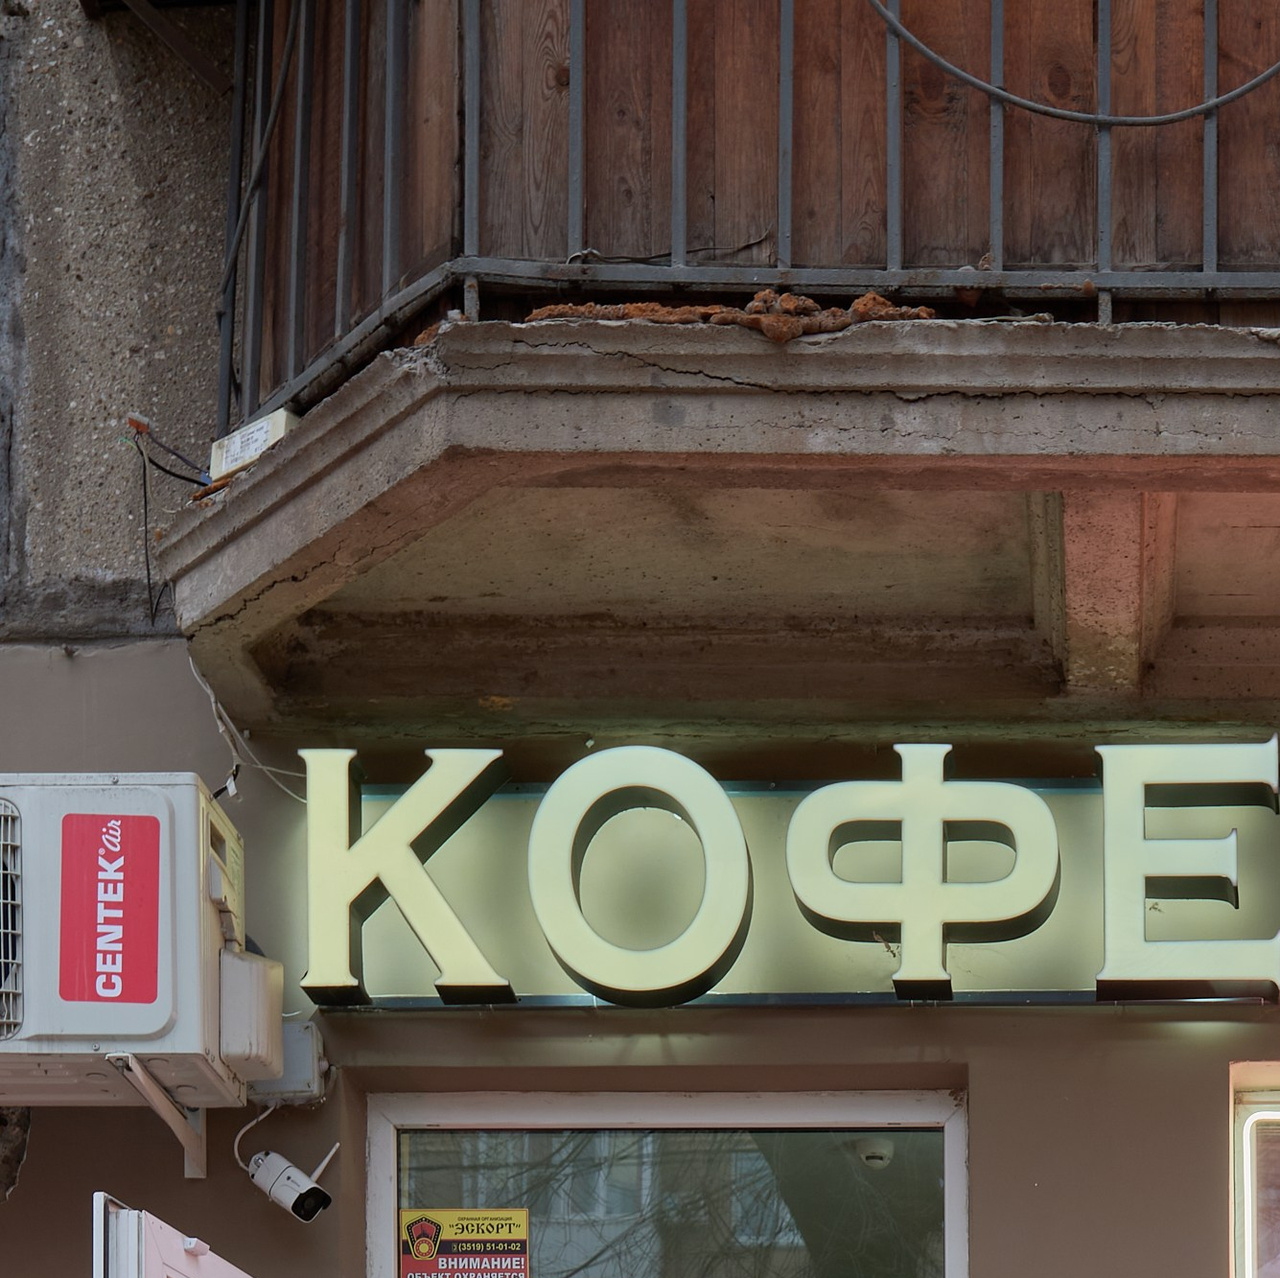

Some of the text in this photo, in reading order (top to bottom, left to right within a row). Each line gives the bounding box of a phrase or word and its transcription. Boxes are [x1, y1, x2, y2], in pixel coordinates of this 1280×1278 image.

[96, 856, 124, 997] CENTEK
[458, 1242, 521, 1252] (3519) 51-01-02
[438, 1257, 525, 1270] ВНИМАНИЕ!
